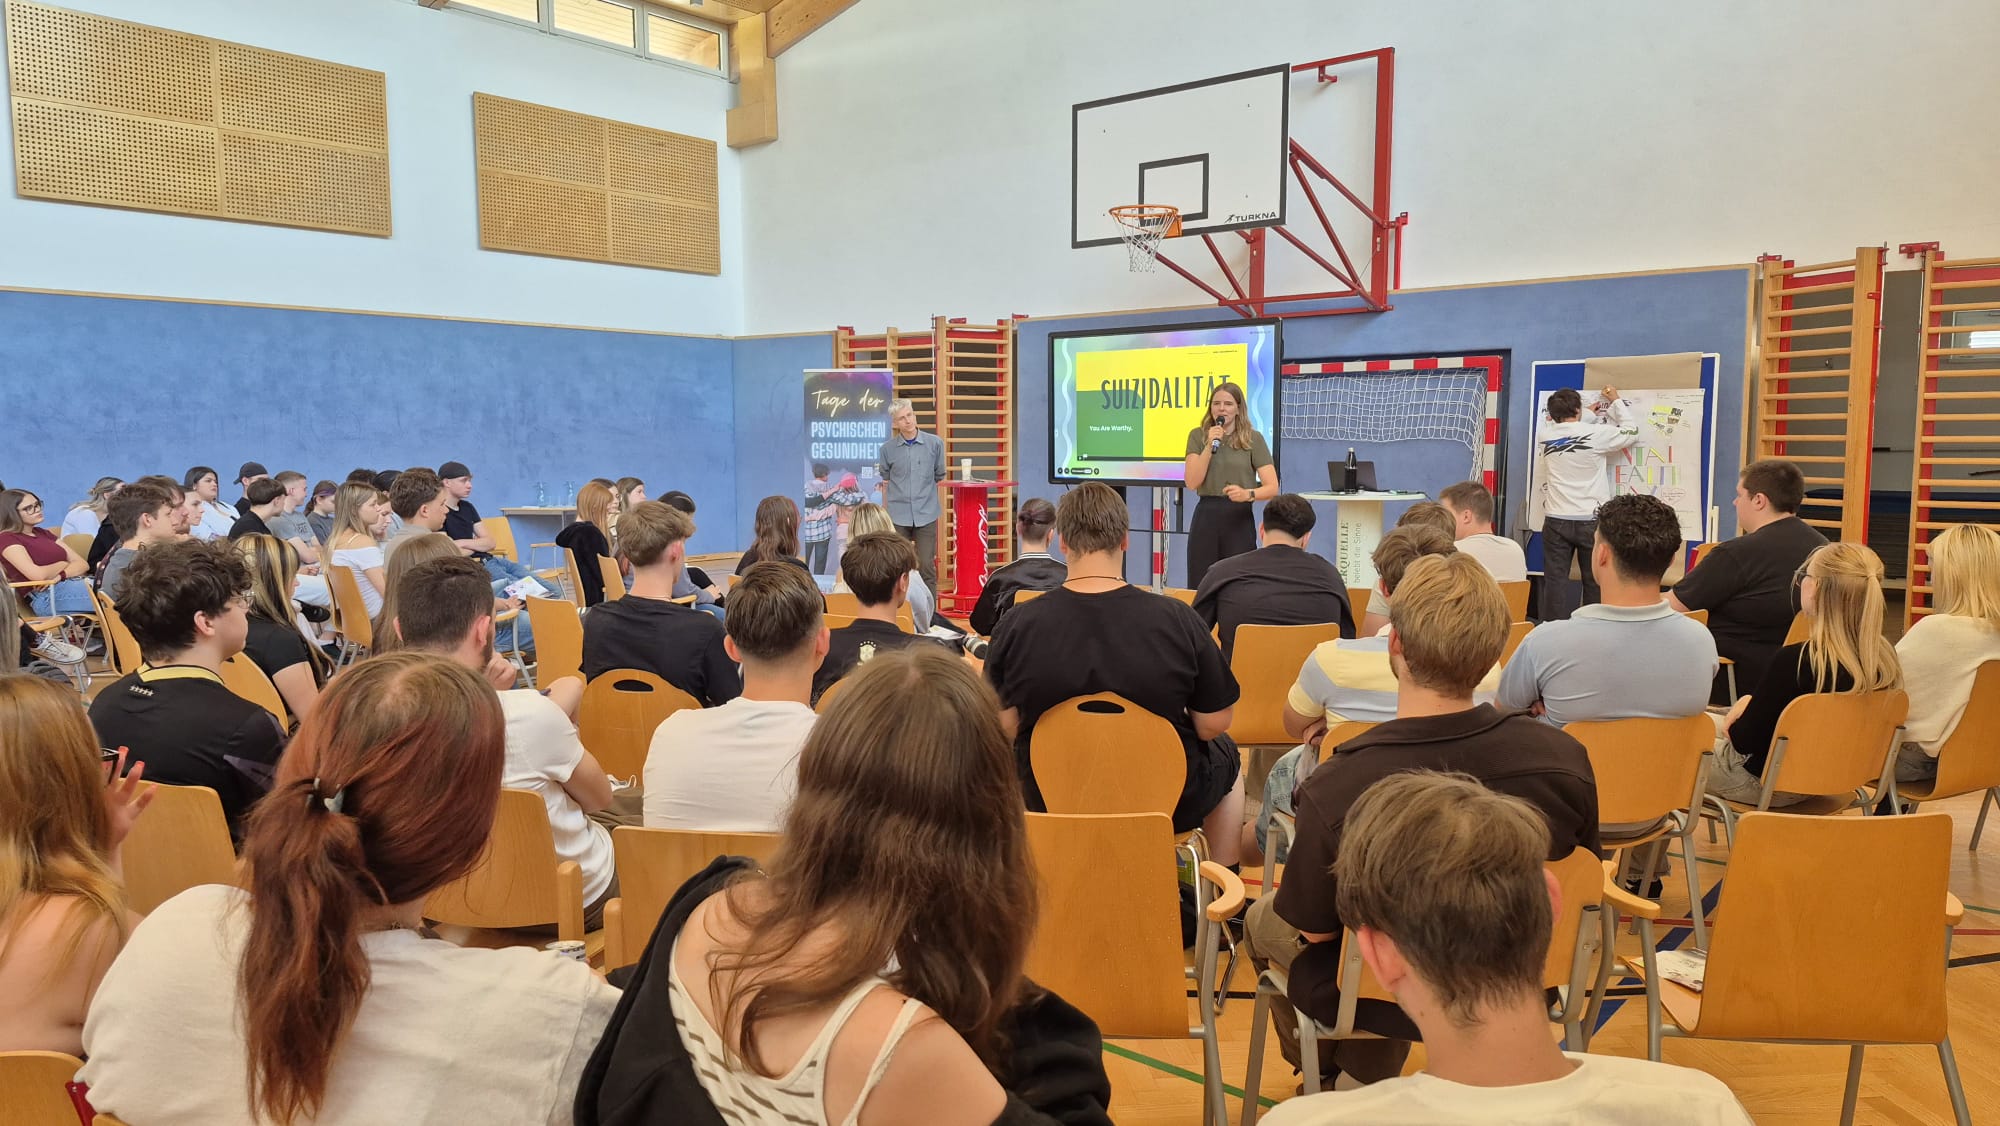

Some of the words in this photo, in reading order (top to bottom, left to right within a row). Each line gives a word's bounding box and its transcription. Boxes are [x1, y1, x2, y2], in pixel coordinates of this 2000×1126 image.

[1235, 211, 1276, 222] TURKNA
[811, 389, 850, 417] Tage
[859, 388, 885, 412] der
[811, 421, 886, 438] PSYCHISCHEN
